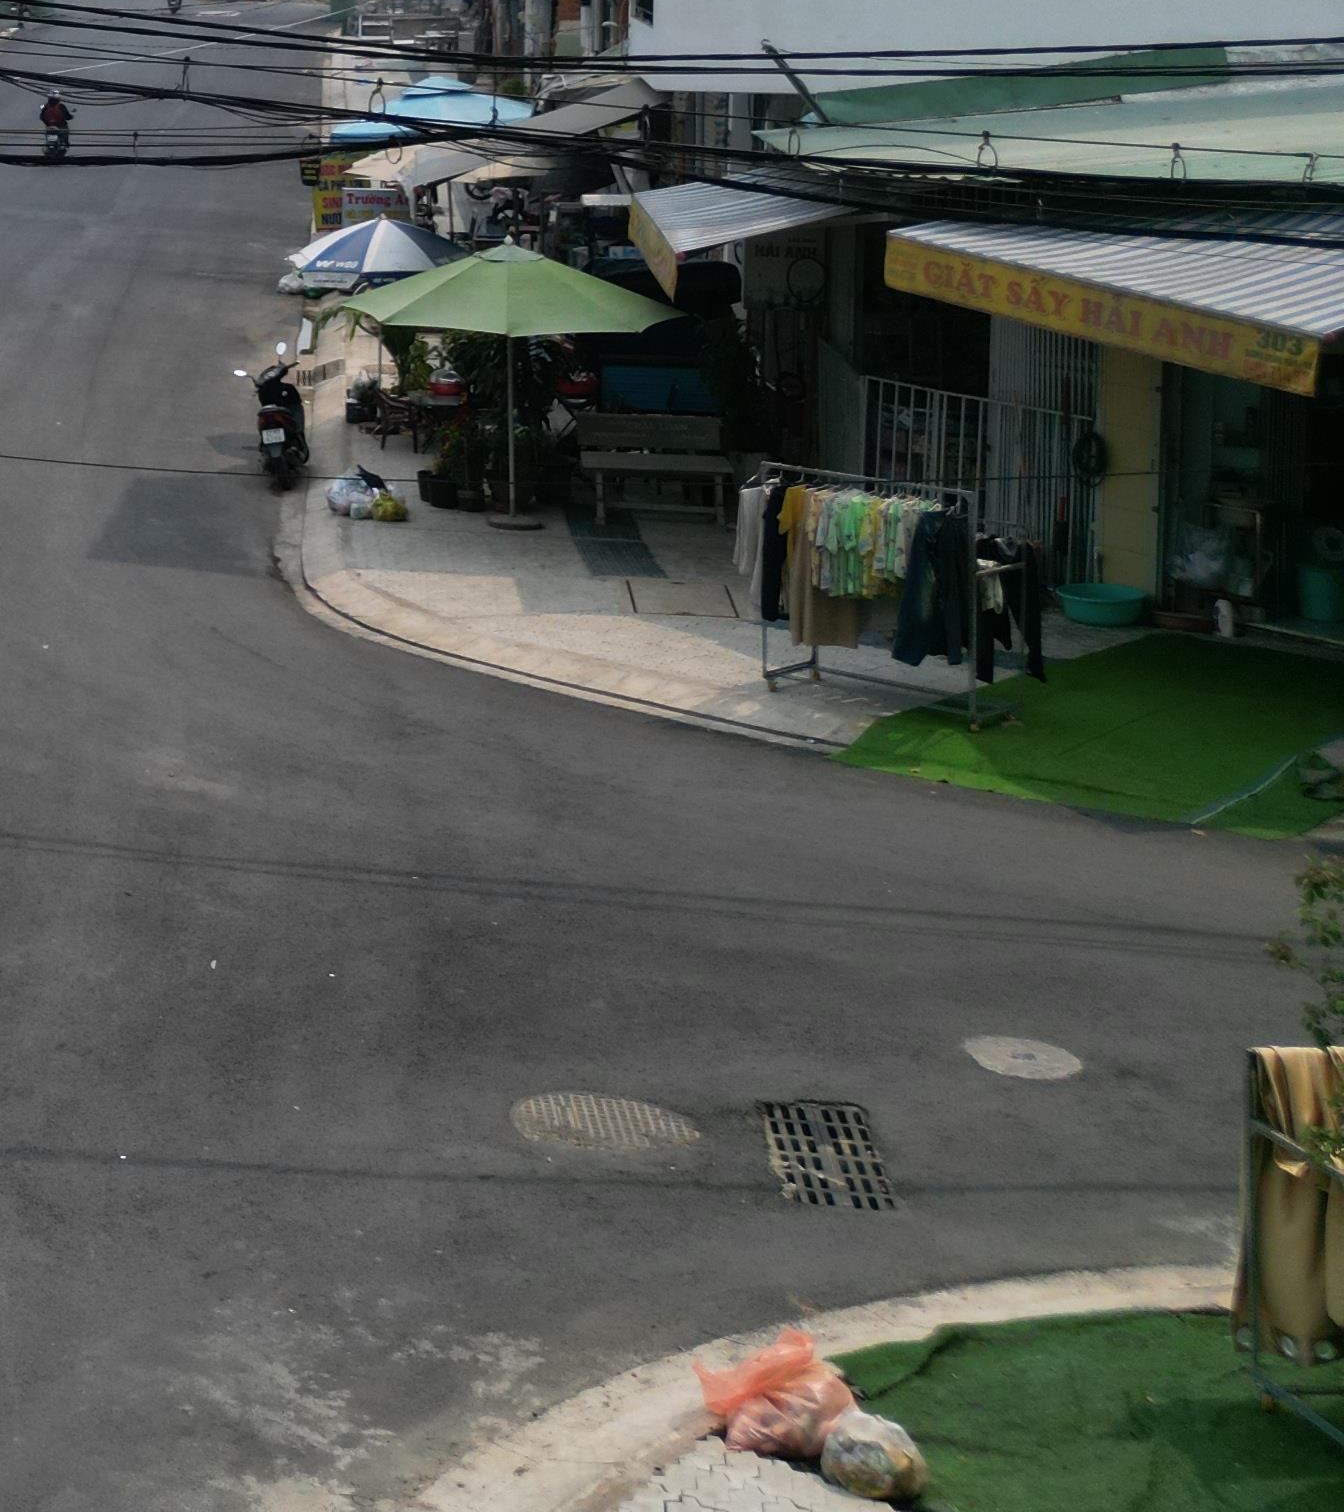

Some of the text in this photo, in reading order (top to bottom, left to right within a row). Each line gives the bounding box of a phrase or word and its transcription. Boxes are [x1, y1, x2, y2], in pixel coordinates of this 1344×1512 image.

[922, 258, 997, 299] GIẶT
[1006, 276, 1074, 319] SẤY
[1079, 291, 1141, 337] HẢI
[1149, 320, 1234, 361] ANH
[1256, 328, 1304, 356] 303
